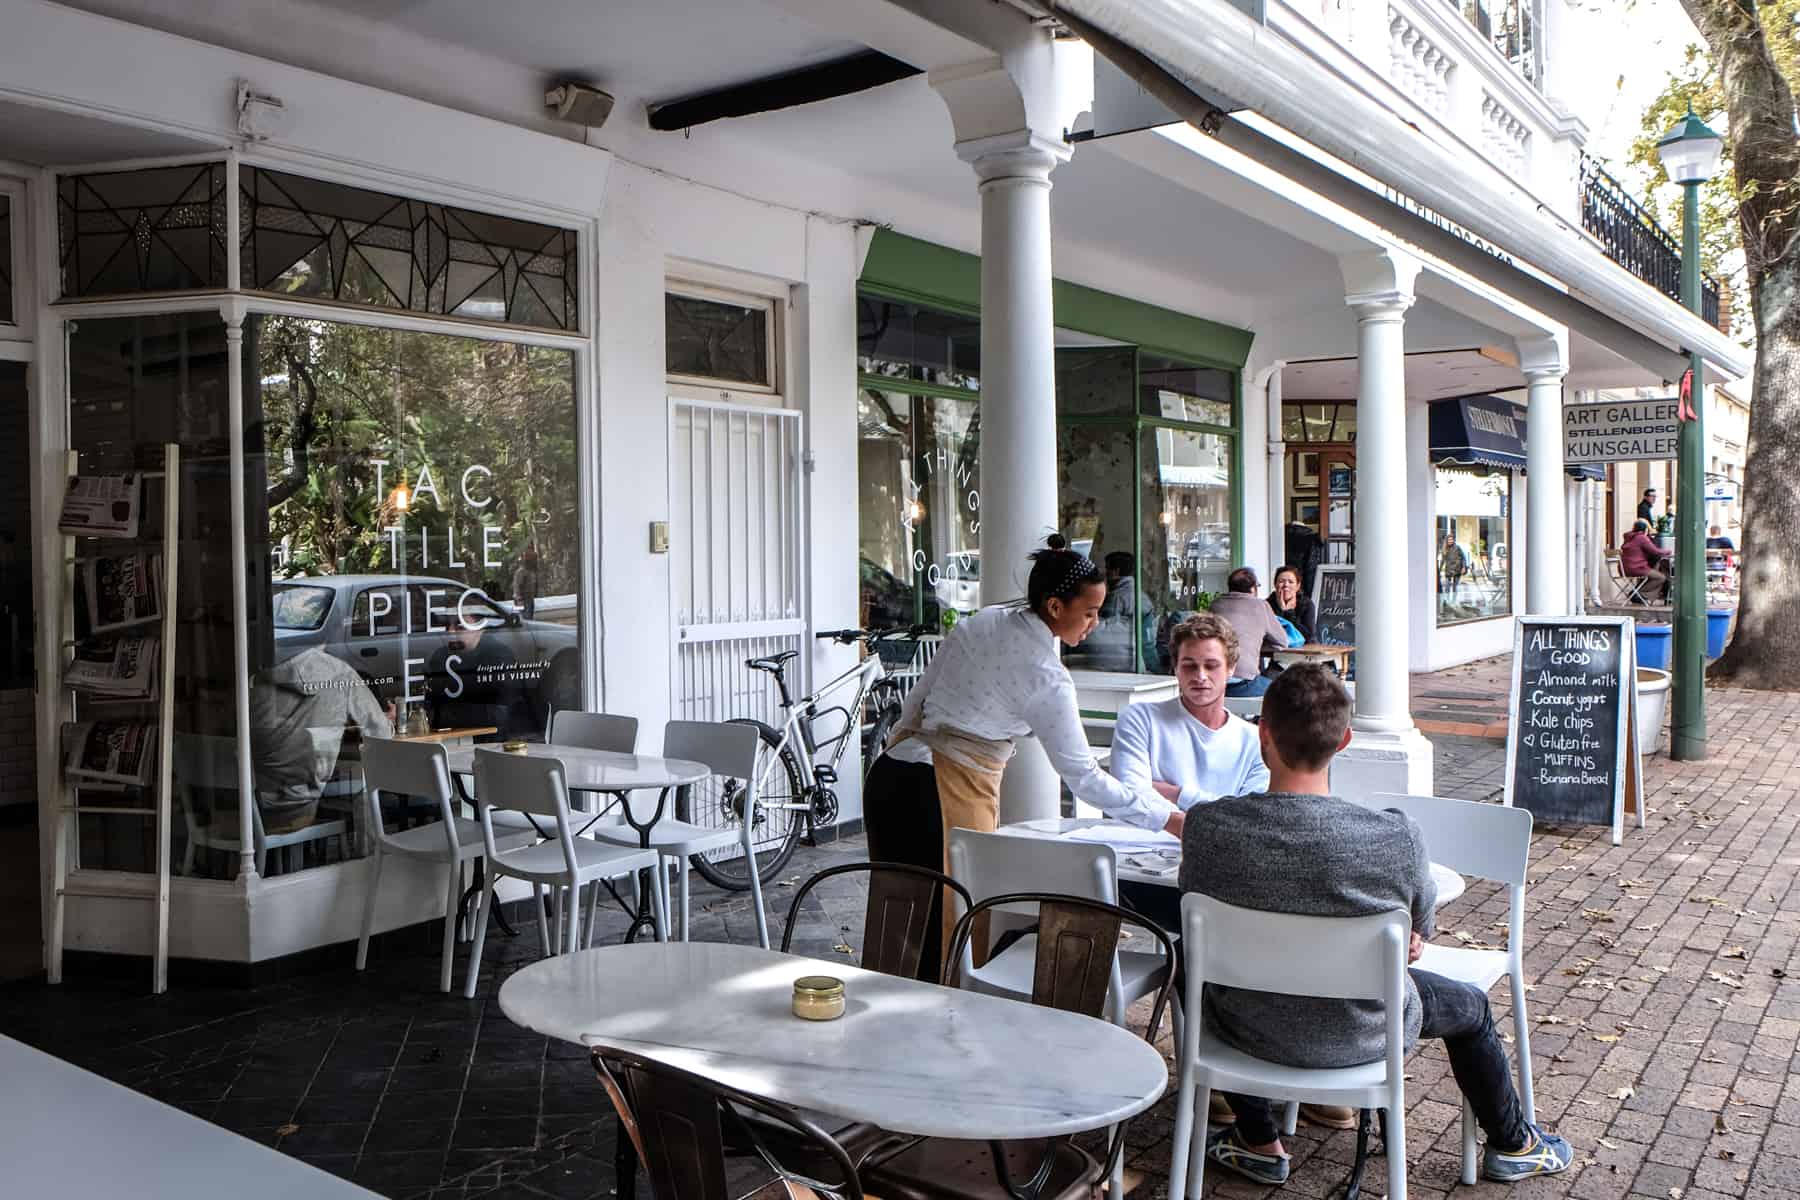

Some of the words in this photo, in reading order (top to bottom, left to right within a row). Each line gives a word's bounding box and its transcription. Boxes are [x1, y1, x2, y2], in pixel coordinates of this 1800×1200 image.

[1566, 409, 1600, 424] ART
[1568, 425, 1680, 438] STELLENBOSC
[369, 459, 492, 511] TAC
[384, 525, 503, 569] TILE
[913, 549, 971, 586] GOOD
[368, 588, 489, 637] PIEC
[1529, 629, 1557, 652] ALL
[1558, 628, 1610, 651] THINGS
[1551, 650, 1591, 665] GOOD
[404, 654, 464, 703] ES
[497, 673, 506, 681] IS
[510, 671, 541, 680] VISUAL
[1592, 674, 1617, 687] milk
[1564, 712, 1594, 734] chips
[1540, 732, 1579, 750] Gluten
[1581, 734, 1601, 750] free
[1580, 770, 1609, 786] Bread
